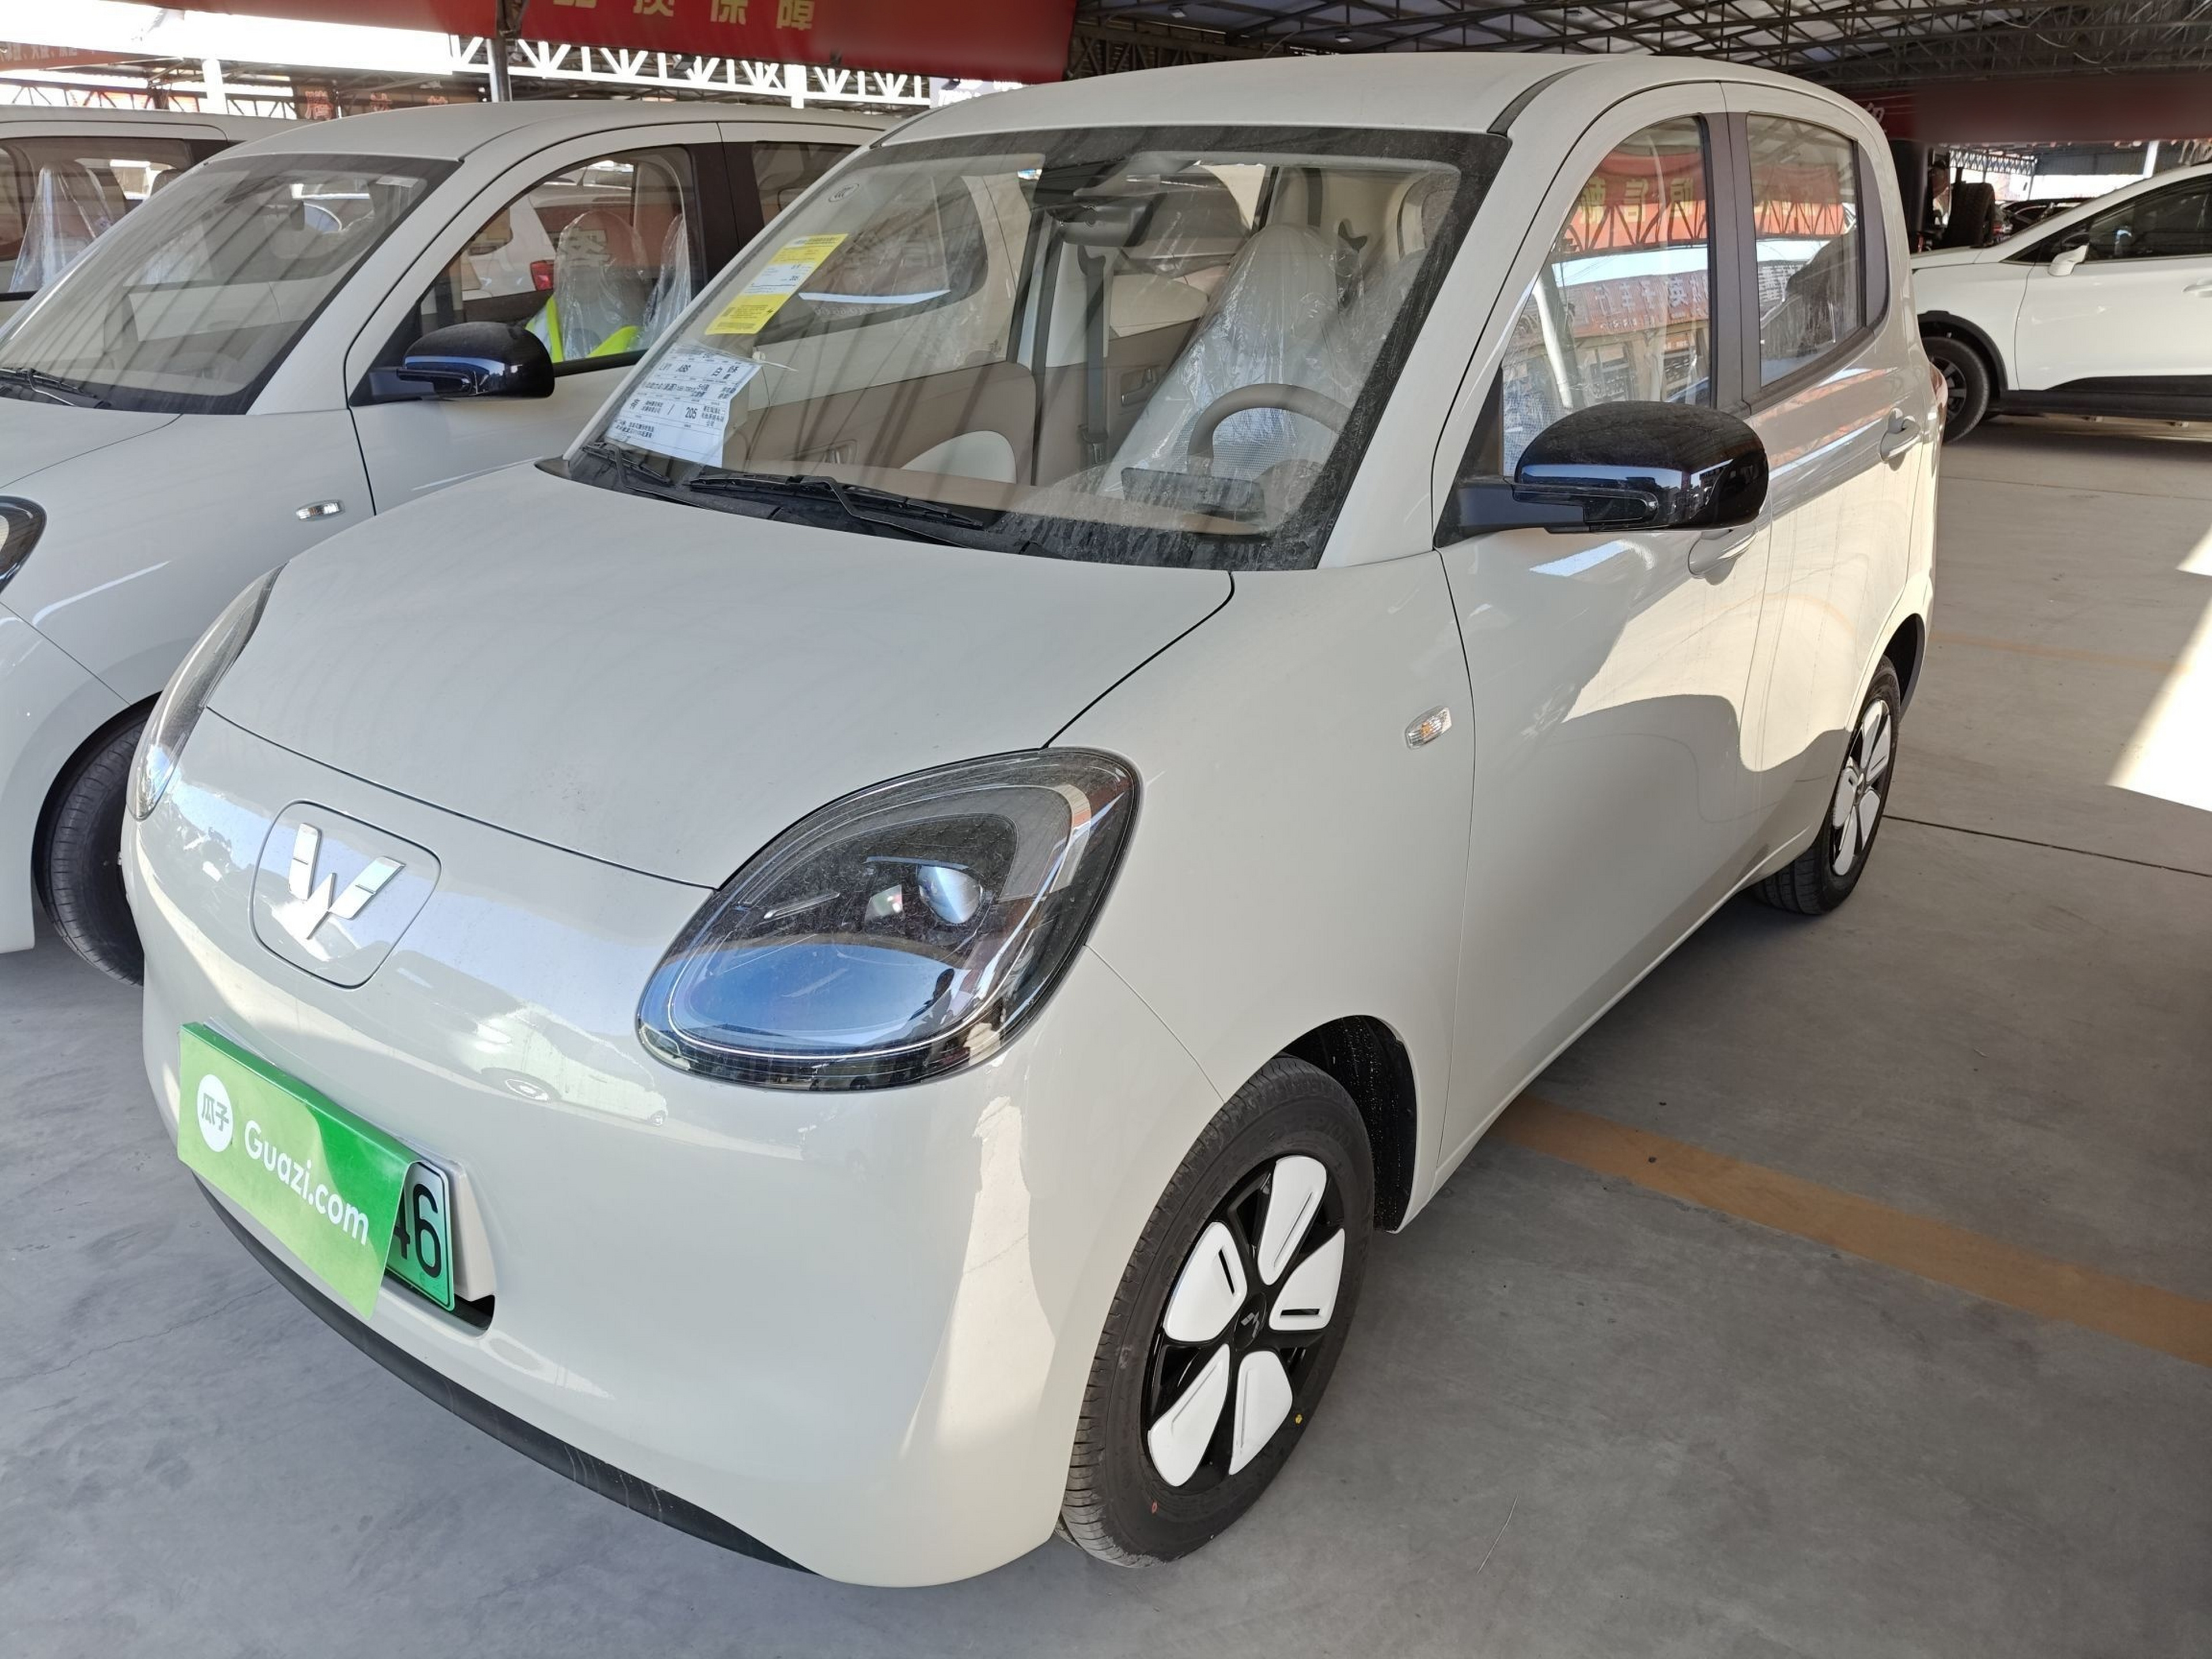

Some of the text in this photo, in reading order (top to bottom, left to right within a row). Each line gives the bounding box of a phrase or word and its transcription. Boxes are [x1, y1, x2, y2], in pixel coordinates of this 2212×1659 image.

[685, 407, 698, 419] 205
[201, 1093, 369, 1245] 瓜子 Guazi.com
